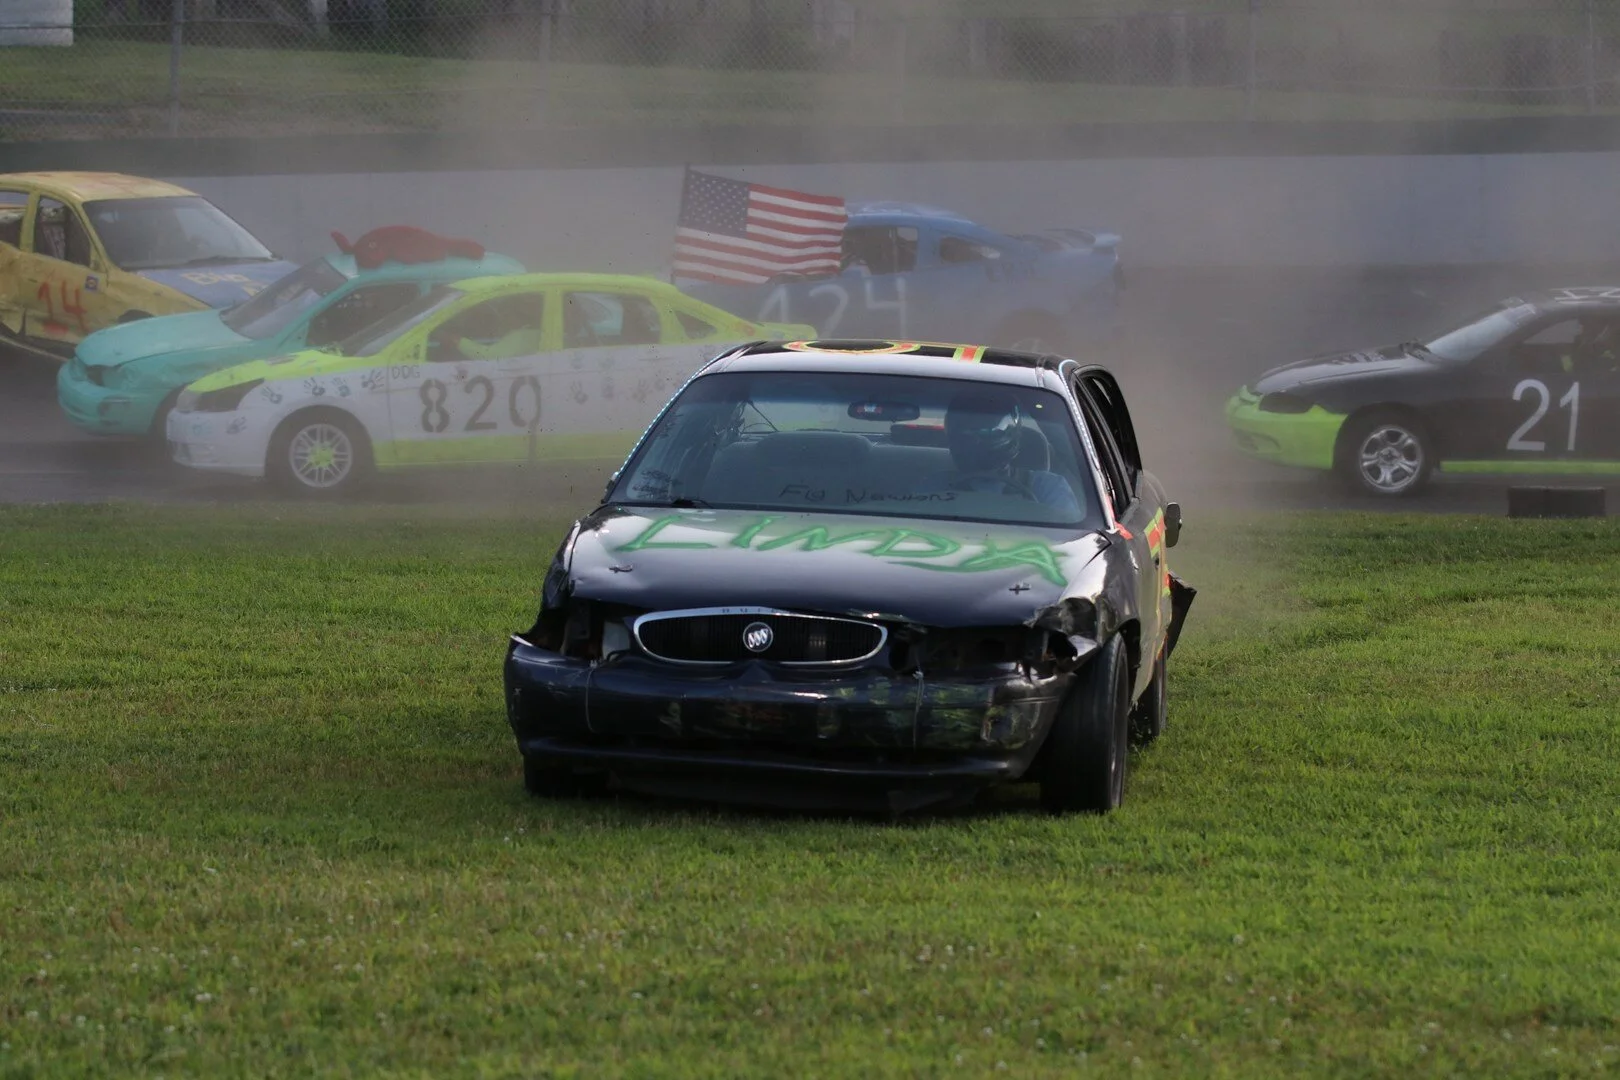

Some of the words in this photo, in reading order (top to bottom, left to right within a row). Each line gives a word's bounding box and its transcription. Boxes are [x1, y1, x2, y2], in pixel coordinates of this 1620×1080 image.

[36, 278, 91, 335] 14
[418, 373, 543, 434] 820
[1506, 378, 1581, 452] 21
[616, 513, 1069, 587] LINDA
